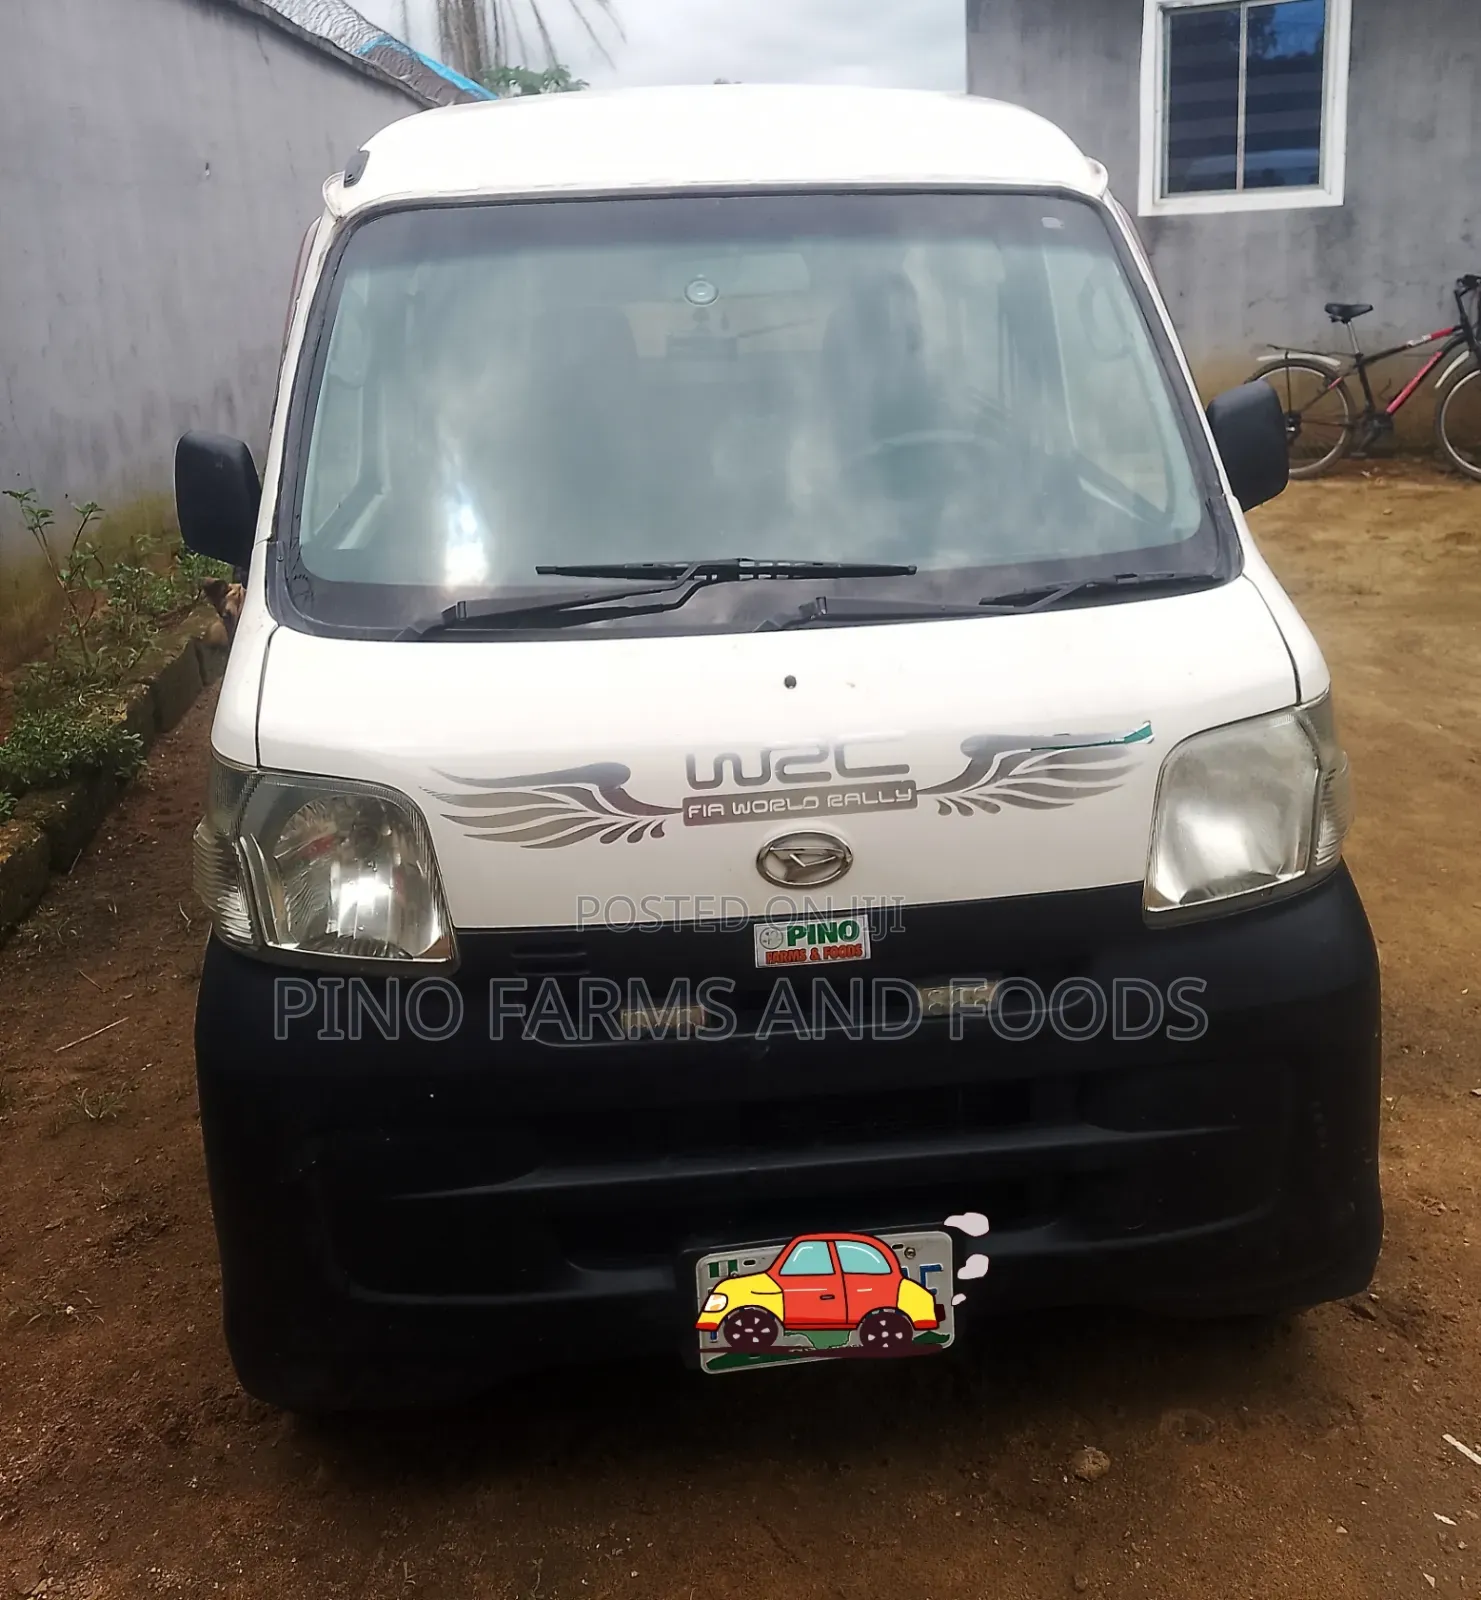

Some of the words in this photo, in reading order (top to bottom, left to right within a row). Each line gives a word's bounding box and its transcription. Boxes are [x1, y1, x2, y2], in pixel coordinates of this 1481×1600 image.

[688, 803, 724, 819] FIA
[731, 798, 819, 815] WORLD
[827, 788, 912, 807] RALLY
[786, 919, 860, 947] PINO
[809, 947, 821, 961] &
[822, 943, 863, 960] FOODS
